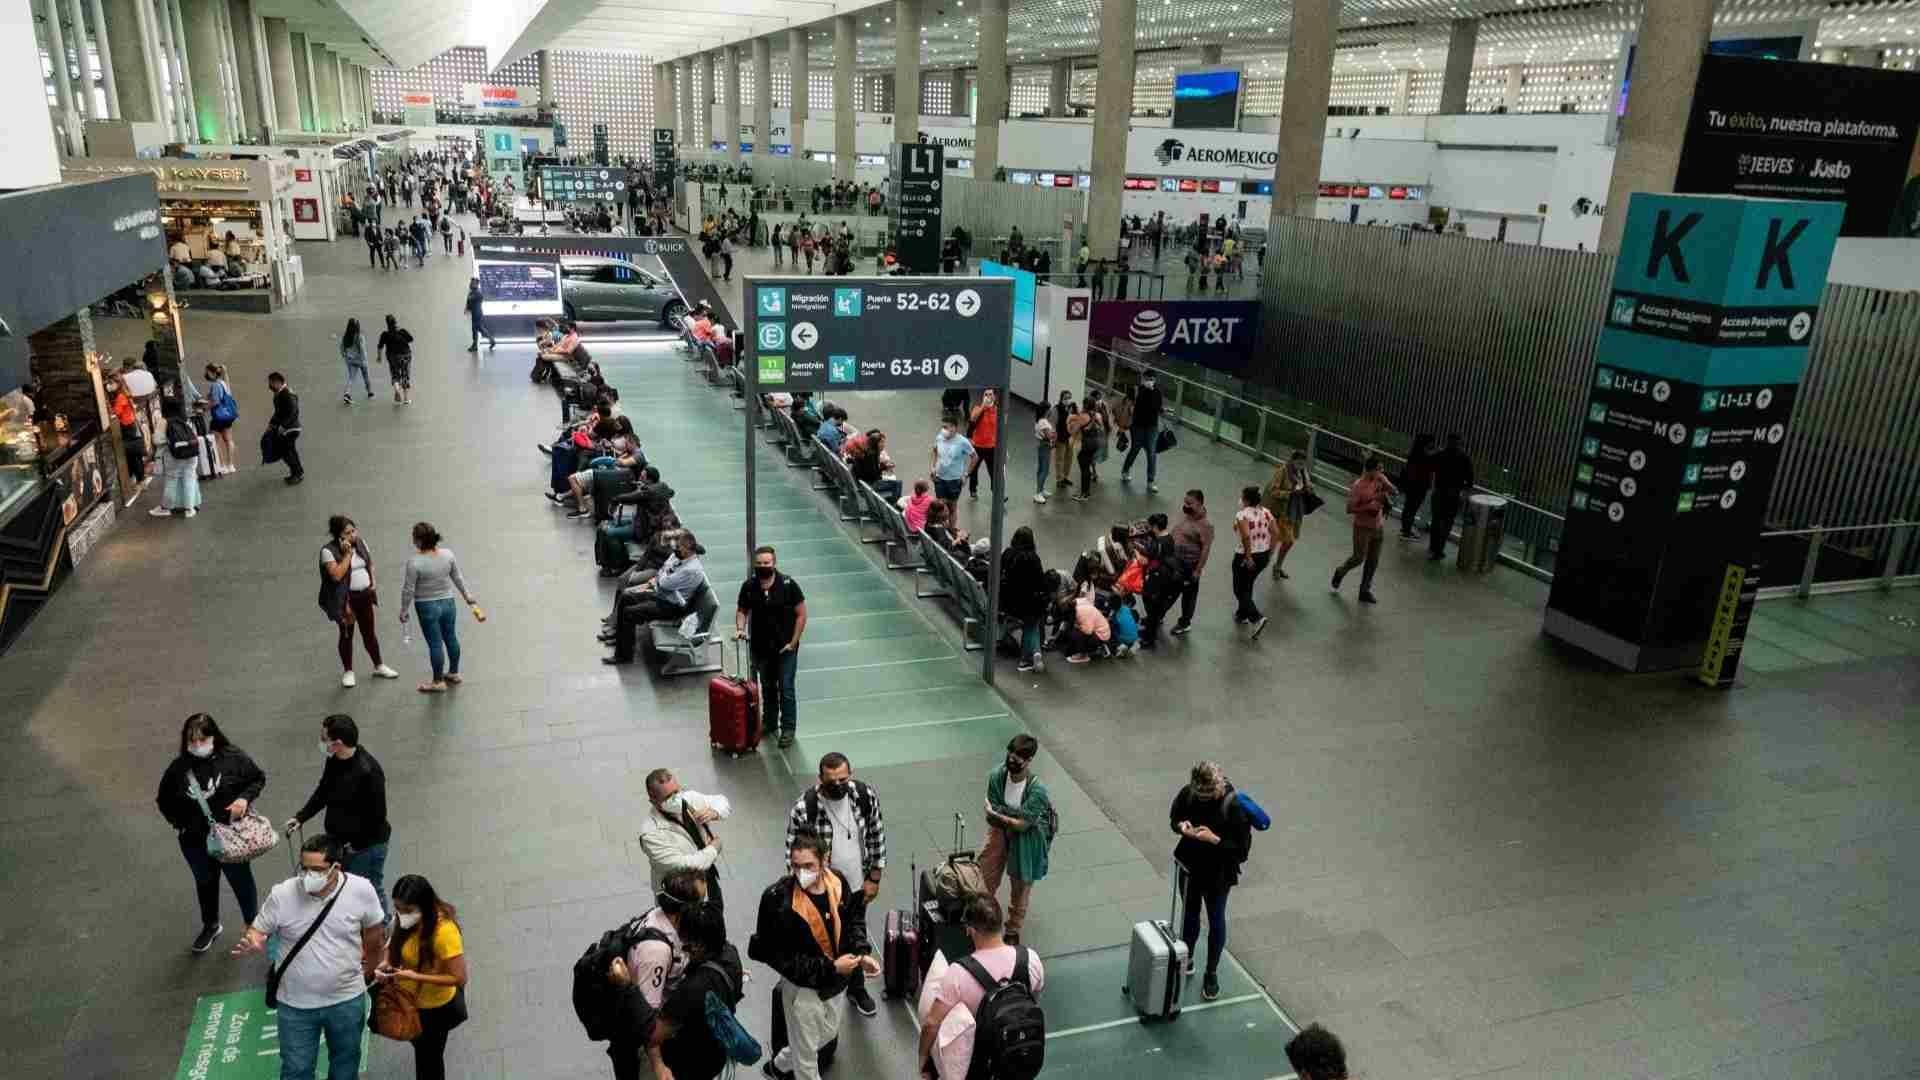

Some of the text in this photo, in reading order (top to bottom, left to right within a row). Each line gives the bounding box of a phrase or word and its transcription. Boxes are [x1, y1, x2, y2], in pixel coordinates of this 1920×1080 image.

[1708, 110, 1727, 127] Tu
[1770, 116, 1822, 133] nuestra
[1823, 118, 1899, 138] plataforma.
[656, 131, 672, 143] L2
[931, 136, 976, 148] AEROME
[911, 148, 935, 174] L1
[1750, 156, 1794, 174] JEEVES
[659, 244, 684, 252] BUICK
[1646, 208, 1704, 283] K
[1755, 217, 1812, 290] K
[791, 293, 829, 304] Migración
[867, 295, 892, 303] Puerta
[896, 293, 950, 311] 52-62
[1721, 316, 1750, 327] Acceso
[1170, 317, 1240, 345] AT&T
[861, 361, 886, 369] Puerta
[890, 358, 940, 376] 63-81
[1614, 375, 1649, 394] L1-L3
[1654, 421, 1668, 437] M
[1754, 427, 1767, 441] M
[652, 966, 664, 988] 3
[203, 1001, 225, 1040] menor
[221, 1008, 249, 1064] Zona de
